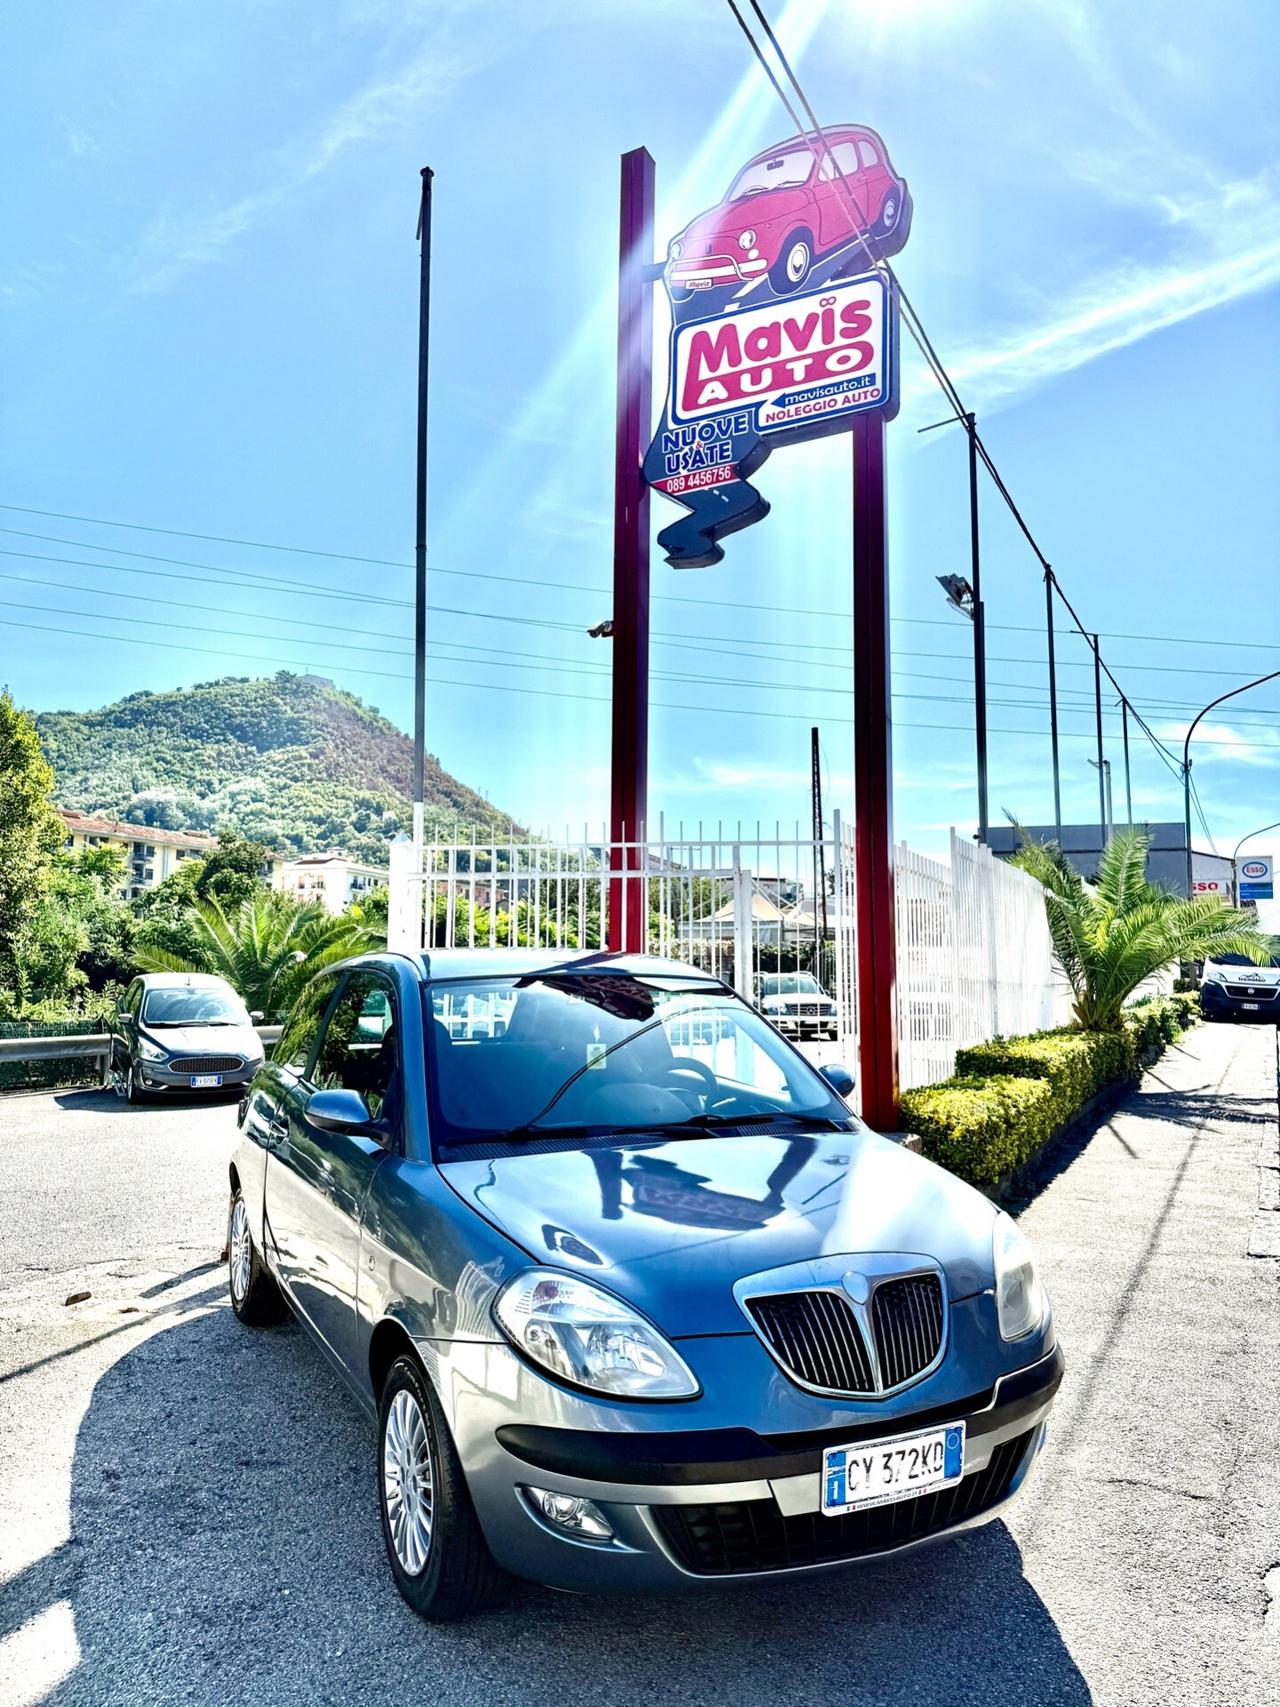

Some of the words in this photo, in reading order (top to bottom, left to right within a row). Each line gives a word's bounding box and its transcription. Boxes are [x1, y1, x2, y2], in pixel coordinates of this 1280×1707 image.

[697, 348, 863, 404] AUTO
[785, 376, 871, 405] mavisauto.it
[765, 398, 838, 424] NOLEGGIO
[841, 388, 881, 406] AUTO
[662, 413, 748, 453] NUOVE
[665, 440, 732, 474] USATE
[667, 477, 685, 492] 089
[688, 466, 731, 487] 4456756
[848, 1455, 874, 1491] CY
[883, 1441, 944, 1484] 372KD
